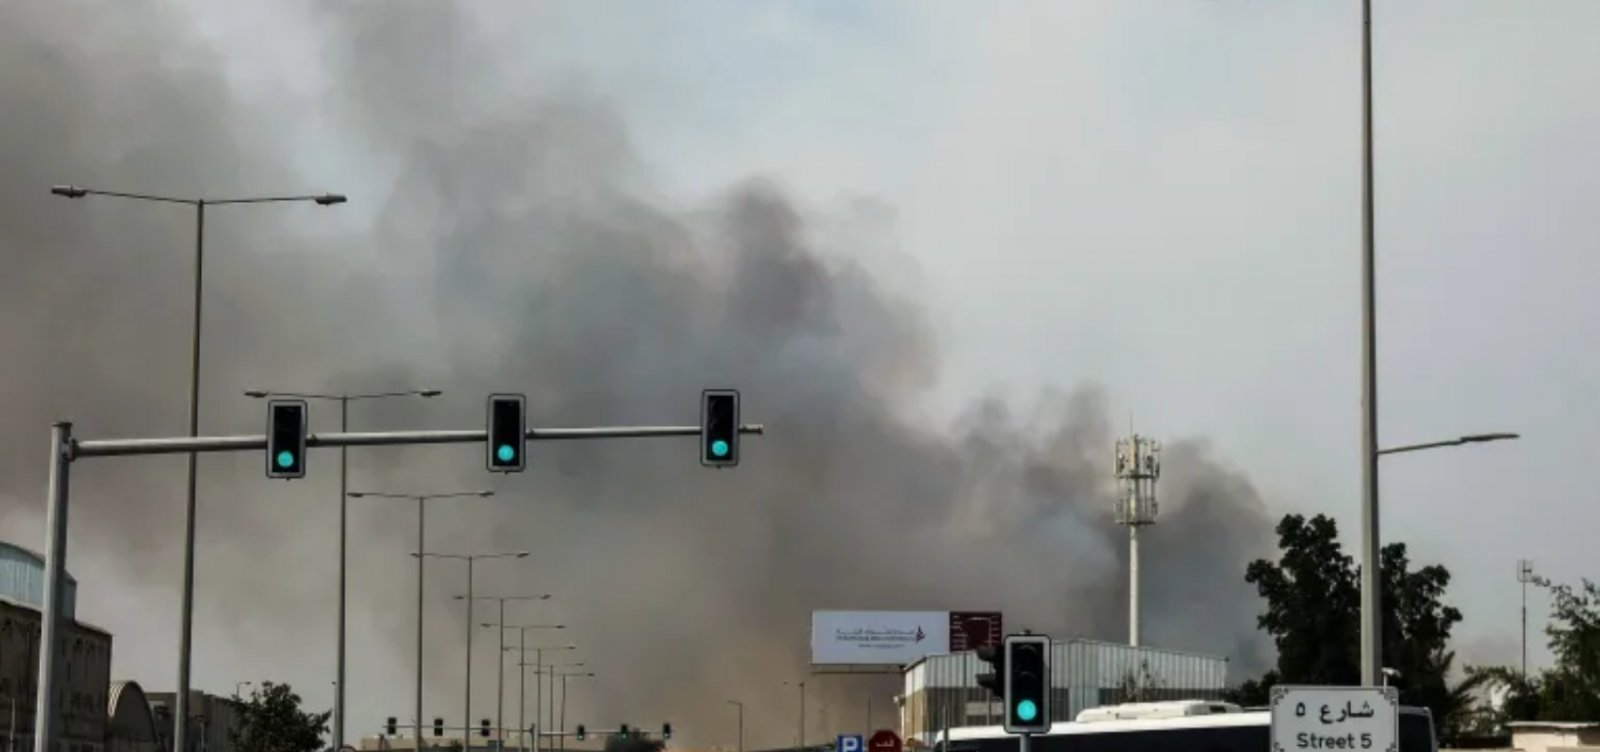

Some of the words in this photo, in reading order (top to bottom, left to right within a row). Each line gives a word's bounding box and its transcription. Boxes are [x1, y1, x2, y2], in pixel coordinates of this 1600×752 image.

[1319, 700, 1374, 724] شارع
[842, 737, 858, 752] P
[1297, 733, 1355, 749] Street
[1360, 733, 1372, 749] 5
